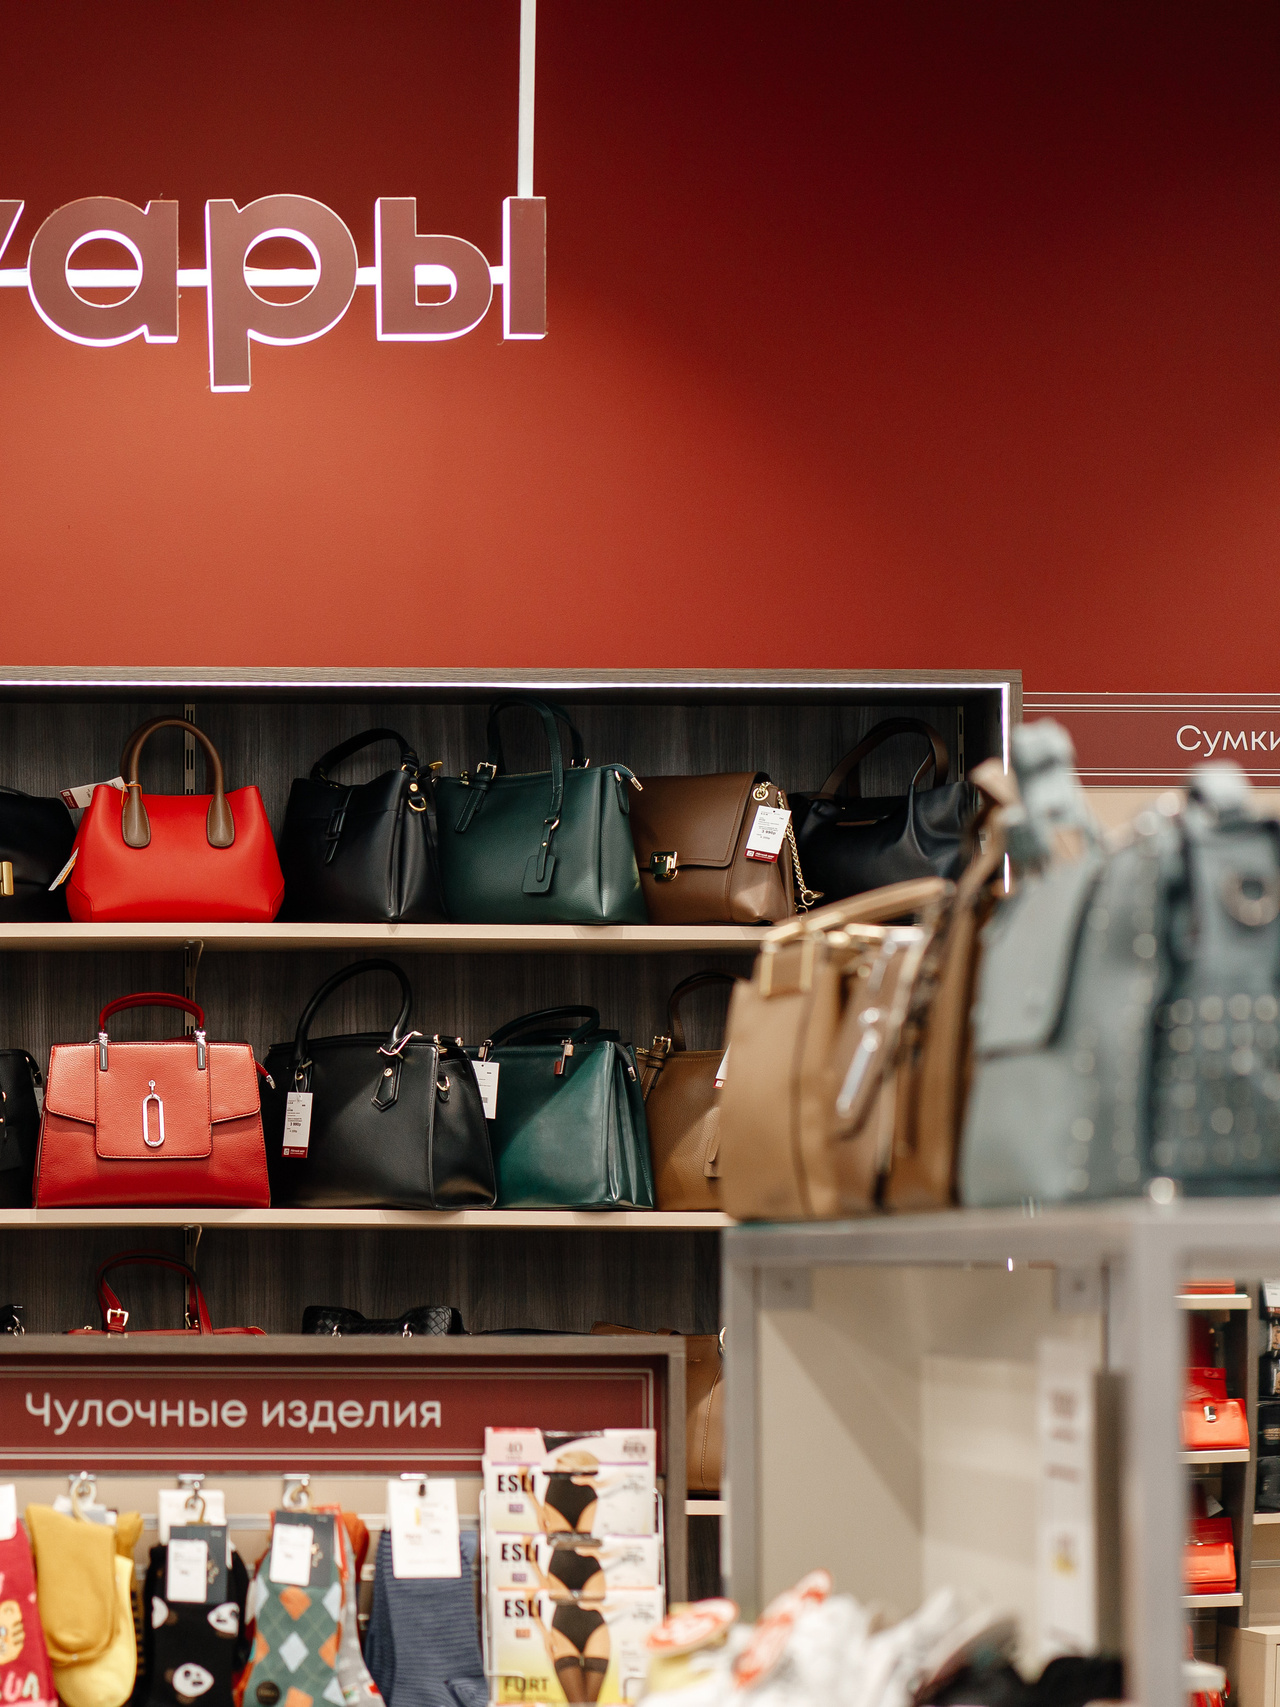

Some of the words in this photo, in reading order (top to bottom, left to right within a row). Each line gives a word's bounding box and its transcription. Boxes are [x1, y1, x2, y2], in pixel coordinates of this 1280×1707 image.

[26, 1393, 248, 1436] Чулочные
[262, 1400, 442, 1434] изделия
[498, 1474, 535, 1493] ESLI
[501, 1543, 539, 1562] ESLI
[504, 1599, 542, 1618] ESLI
